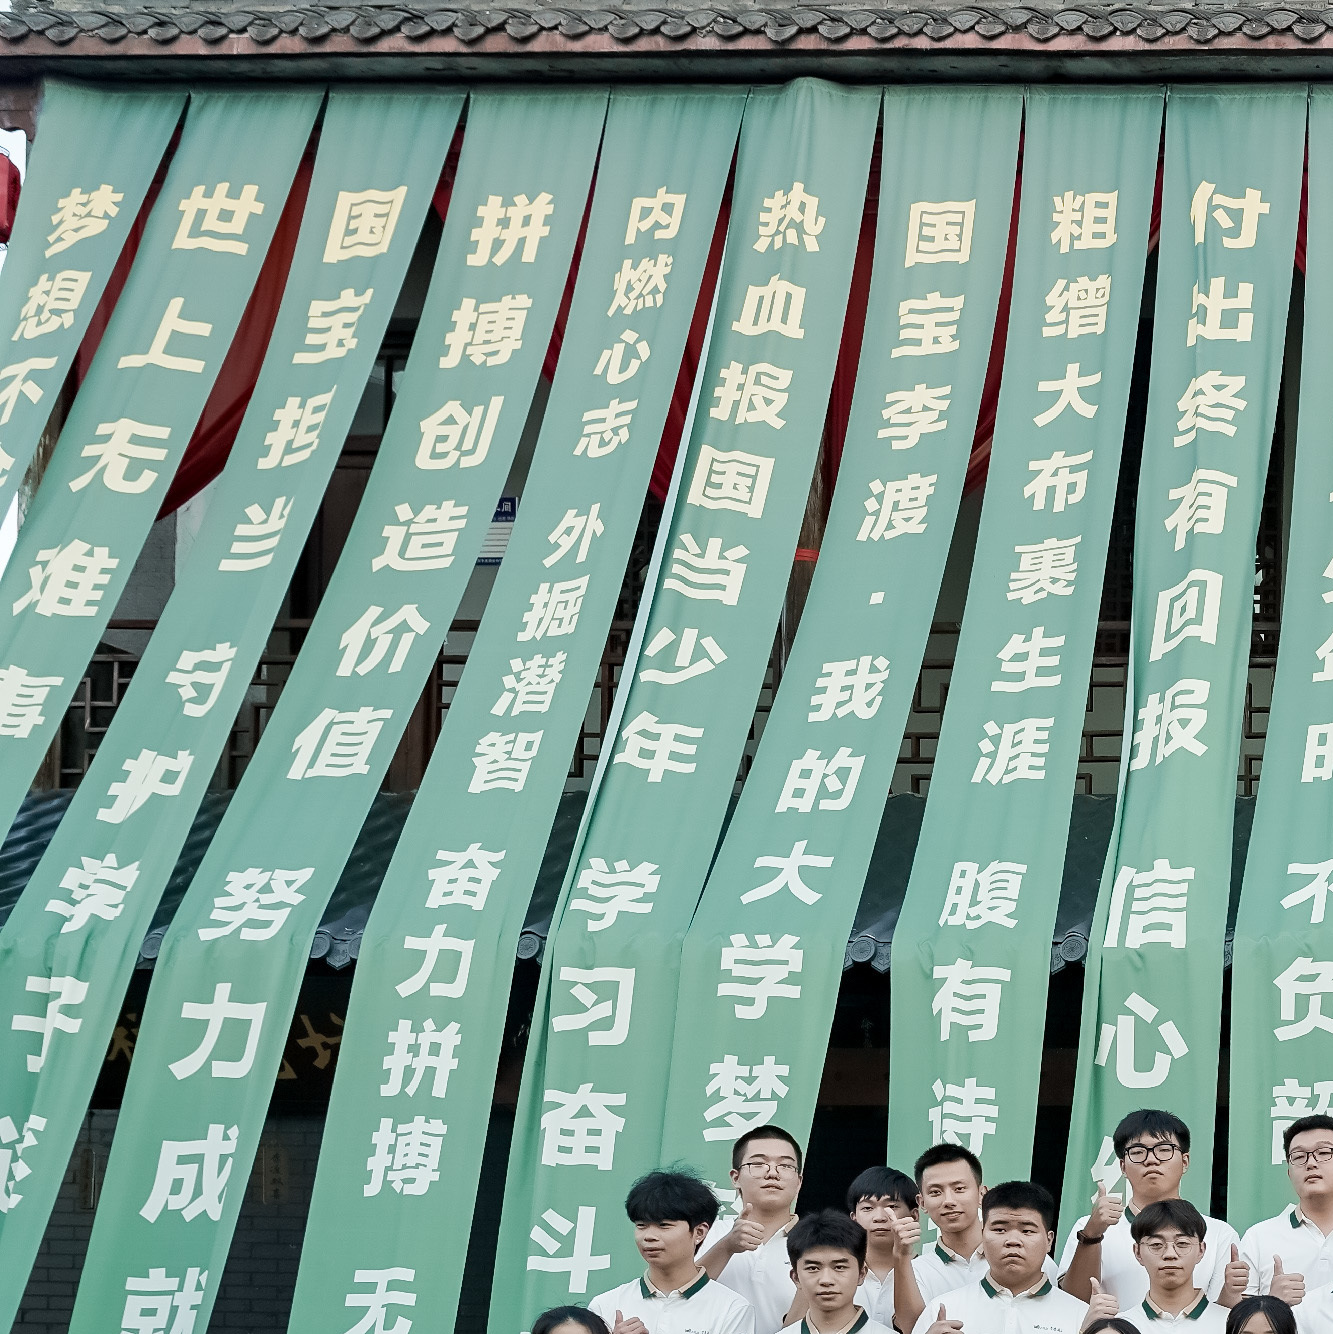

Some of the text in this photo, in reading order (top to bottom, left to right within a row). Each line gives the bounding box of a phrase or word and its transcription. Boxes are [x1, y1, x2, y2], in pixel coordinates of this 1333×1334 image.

[0, 184, 124, 487] 梦想不
[0, 182, 264, 738] 世上无难事
[287, 194, 555, 782] 拼搏创造价值
[573, 186, 687, 459] 内燃心志
[613, 183, 825, 783] 热血报国当少年
[12, 186, 407, 1073] 国宝担当 守护学子
[469, 502, 605, 795] 外掘潜智
[703, 199, 976, 1221] 国宝李渡·我的大学梦
[922, 189, 1120, 1256] 粗缯大布裹生涯 腹有诗
[1090, 181, 1269, 1204] 付出终有回报 信心
[364, 844, 506, 1198] 奋力拼搏
